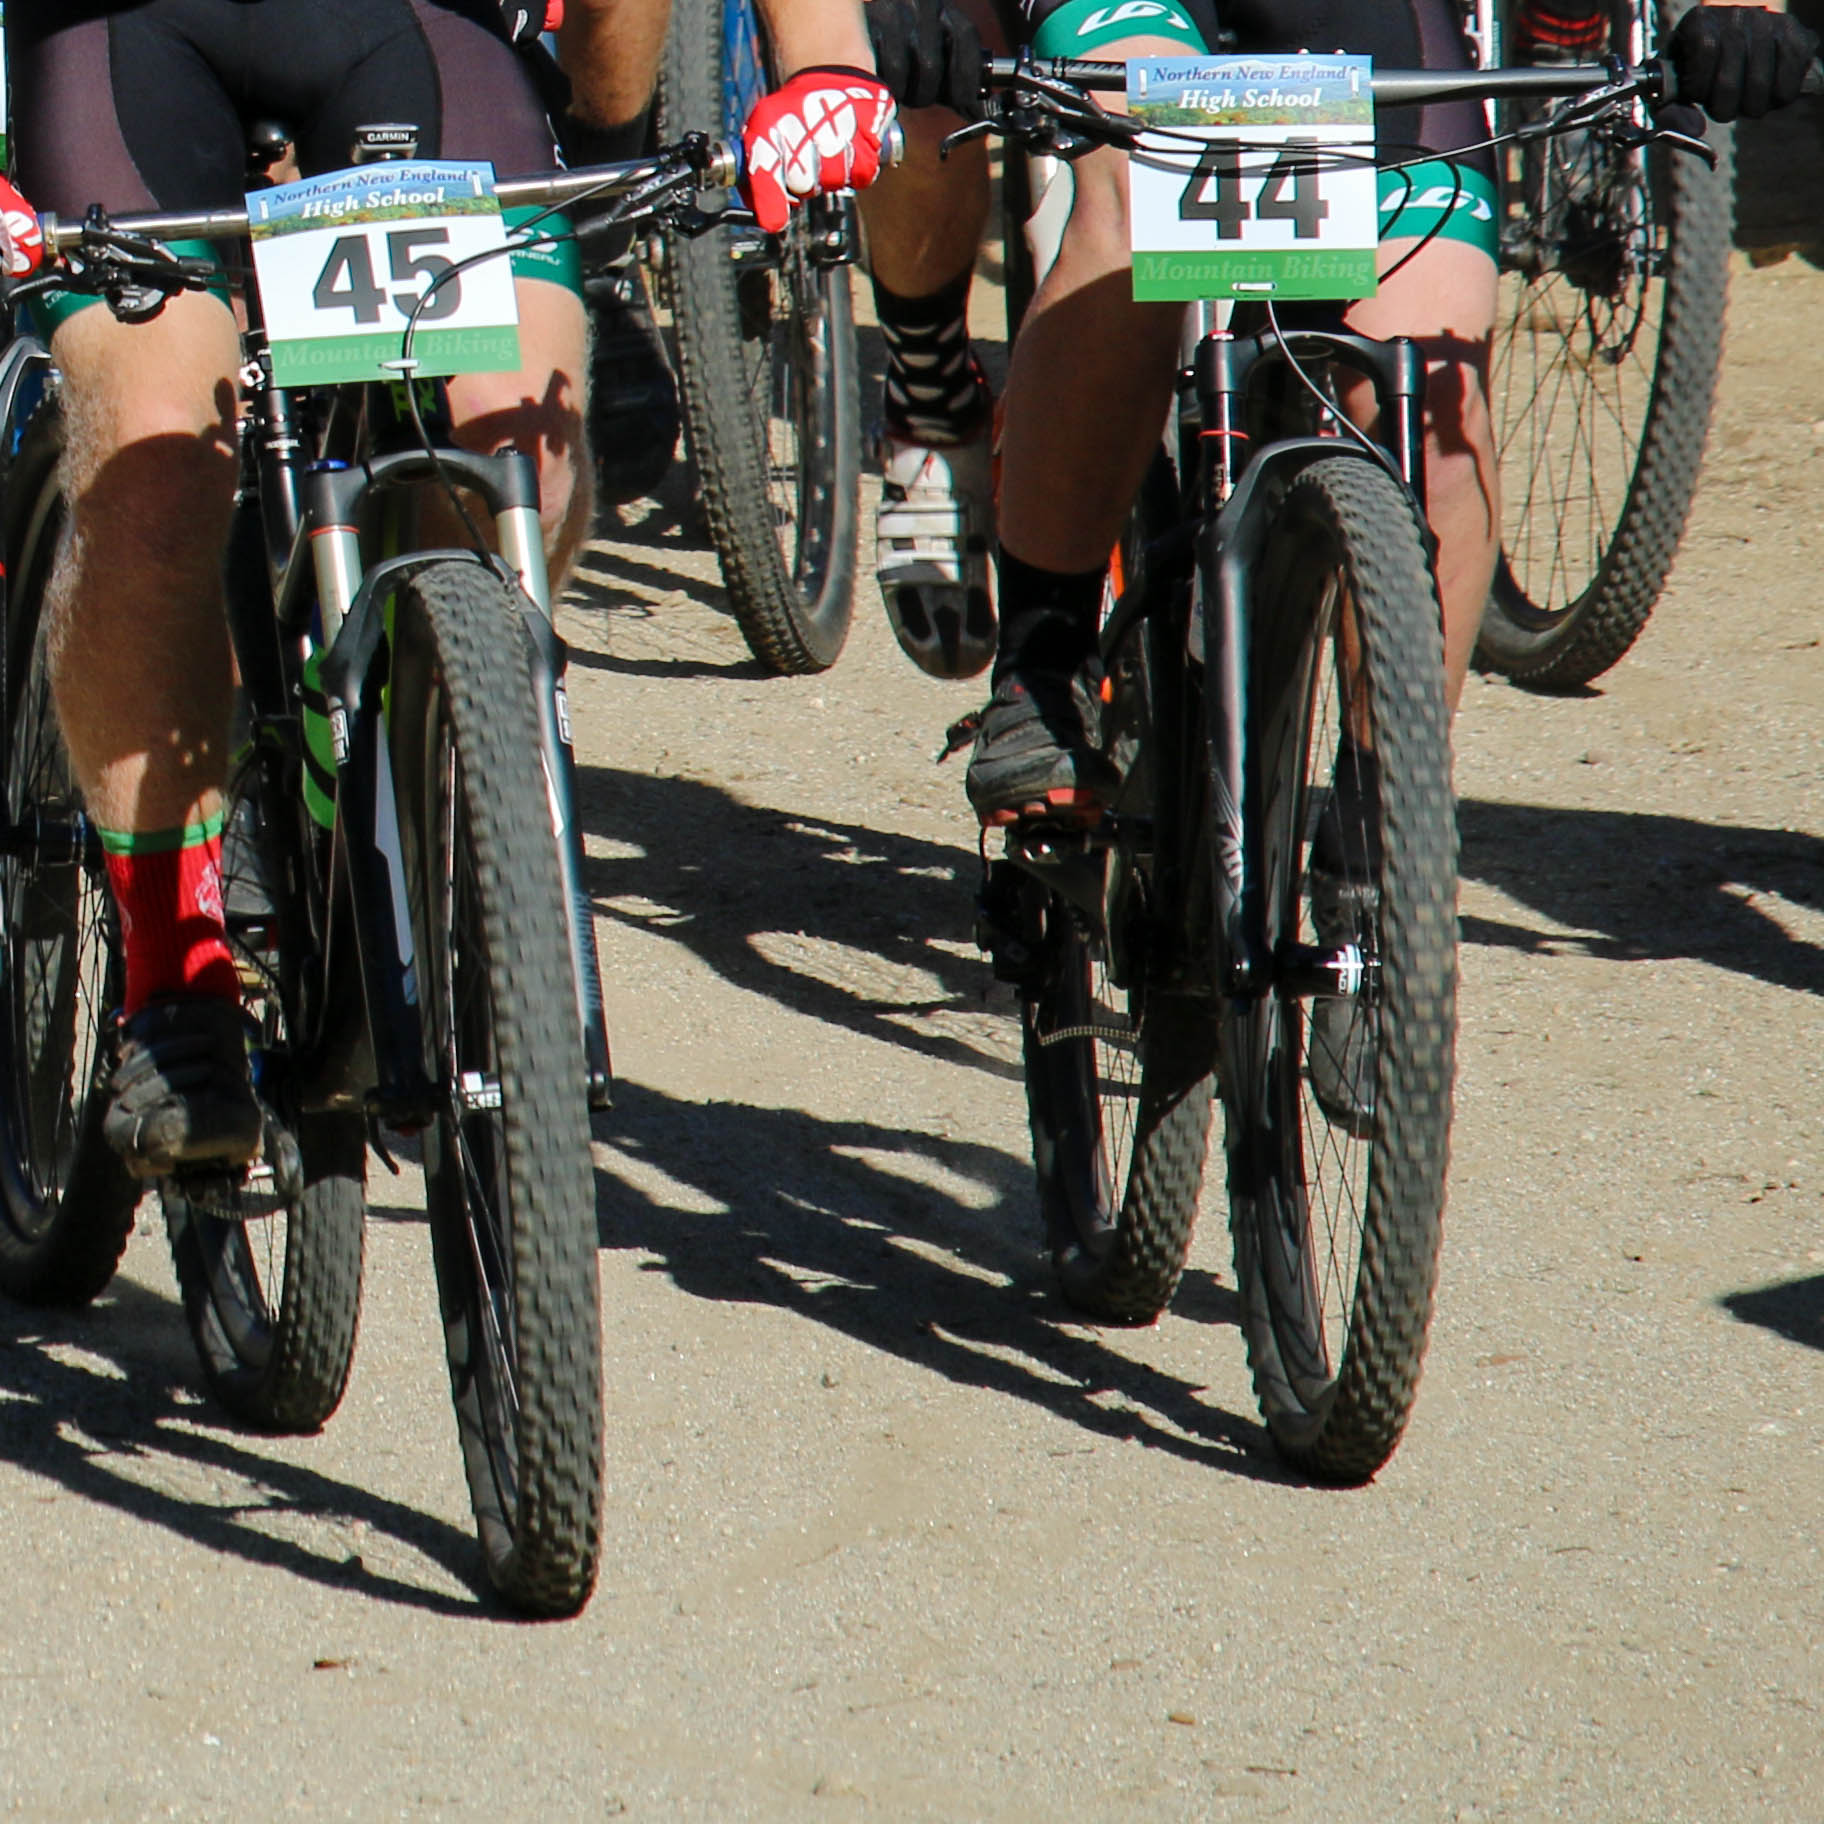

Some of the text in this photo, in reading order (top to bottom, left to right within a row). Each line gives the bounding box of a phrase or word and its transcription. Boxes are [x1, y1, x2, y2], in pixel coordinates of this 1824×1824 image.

[1152, 62, 1351, 84] Northern New England
[1179, 87, 1322, 112] High School
[366, 132, 410, 143] GARMIN
[274, 184, 340, 207] Northern
[381, 170, 470, 192] England
[301, 187, 445, 220] High School
[1179, 137, 1329, 240] 44
[311, 226, 464, 326] 45
[1143, 252, 1371, 286] Mountain Biking
